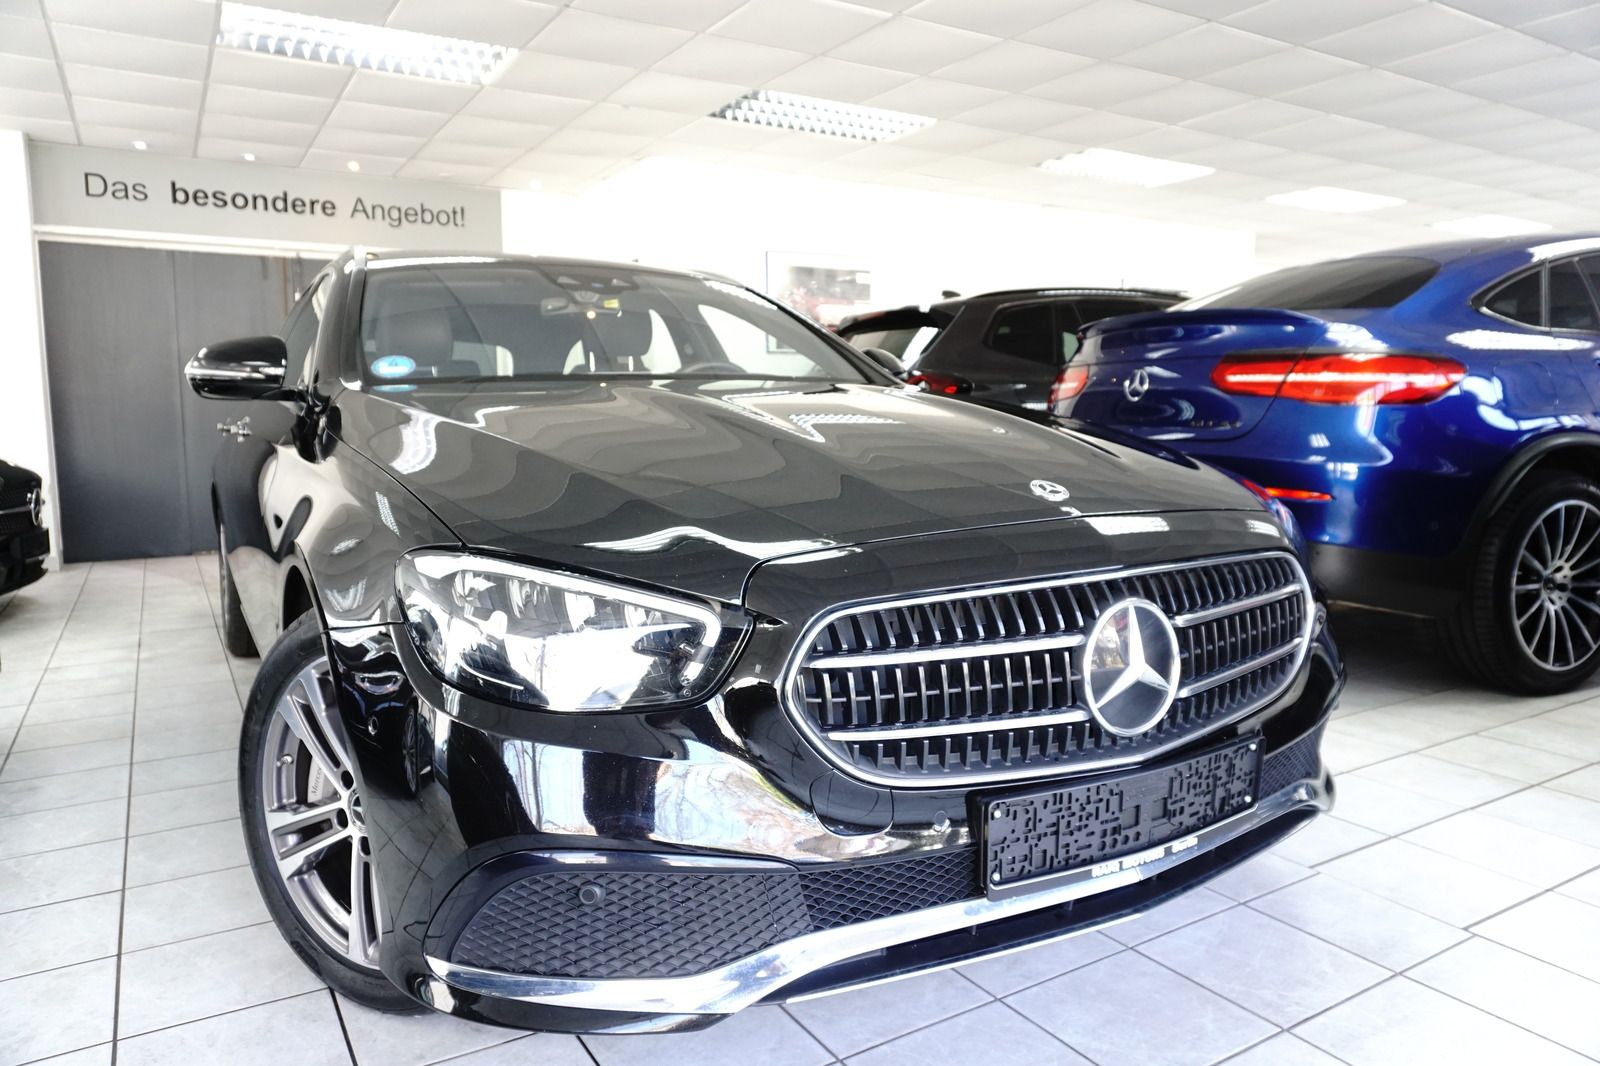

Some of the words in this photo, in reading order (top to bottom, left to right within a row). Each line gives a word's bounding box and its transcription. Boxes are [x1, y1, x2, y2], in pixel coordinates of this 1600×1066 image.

[84, 171, 149, 202] Das
[171, 180, 337, 217] besondere
[350, 197, 466, 228] Angebot!
